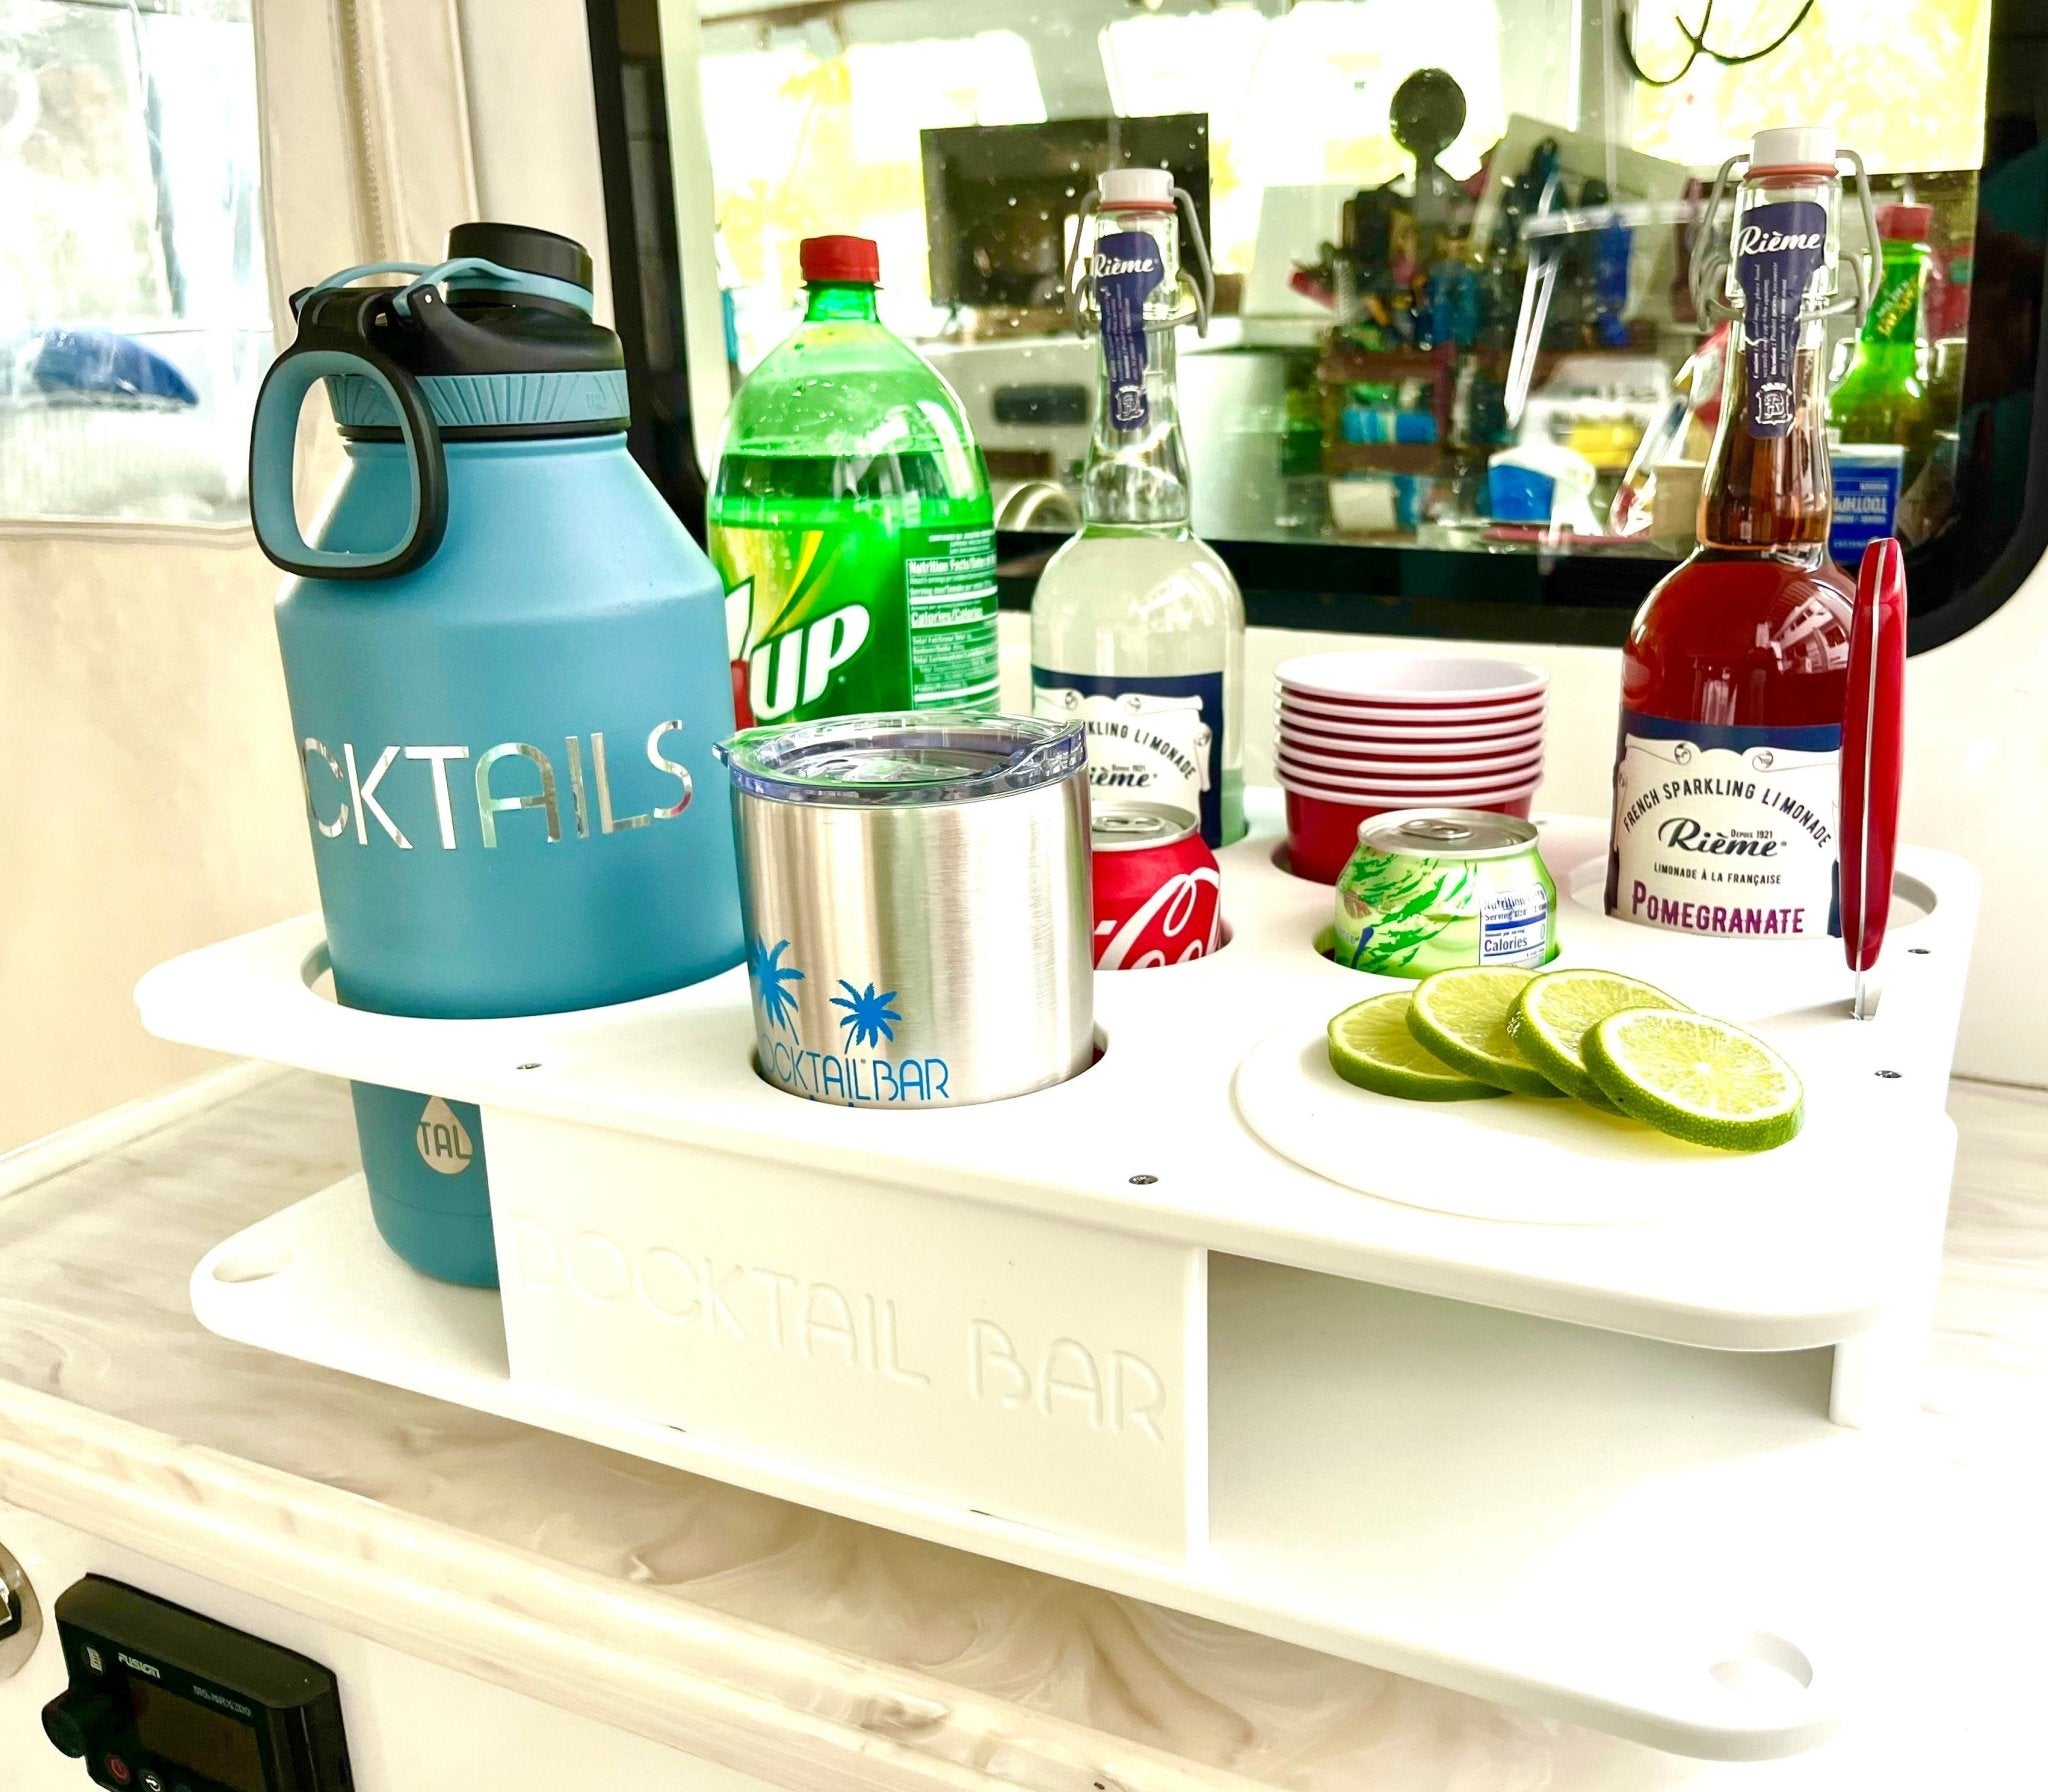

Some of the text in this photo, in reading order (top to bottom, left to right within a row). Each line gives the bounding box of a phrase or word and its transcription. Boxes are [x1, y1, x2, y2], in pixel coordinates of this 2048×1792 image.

[1739, 225, 1821, 256] Rième
[1095, 253, 1155, 278] Rième
[1088, 720, 1196, 780] KLING LIMONADE
[303, 719, 693, 851] CKTAILS
[1090, 766, 1151, 787] ième
[1624, 778, 1832, 848] FRENCH SPARKLING LIMONADE
[1657, 817, 1779, 858] Rième
[1756, 829, 1773, 839] 1921
[1653, 862, 1698, 880] LIMONADE
[1711, 871, 1724, 882] LA
[1727, 872, 1781, 887] FRANÇAISE
[1484, 936, 1528, 952] Calories
[761, 1033, 950, 1102] OCKTAIL BAR
[418, 1121, 473, 1160] TAL
[509, 1211, 1167, 1446] DOCKTAIL BAR
[118, 1652, 161, 1680] FUSION
